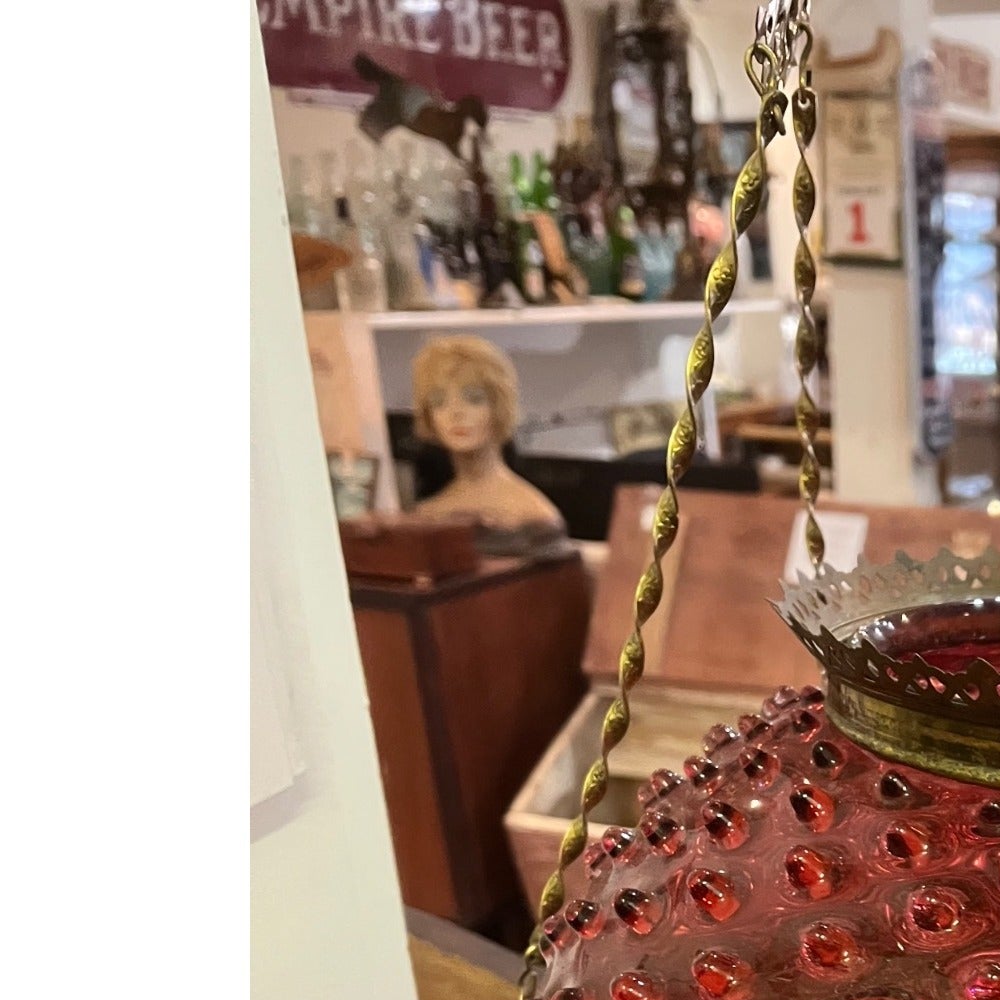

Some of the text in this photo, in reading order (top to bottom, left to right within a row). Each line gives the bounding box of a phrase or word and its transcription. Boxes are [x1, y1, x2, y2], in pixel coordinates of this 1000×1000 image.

[260, 0, 563, 69] MPIRE BEER
[847, 200, 869, 243] 1
